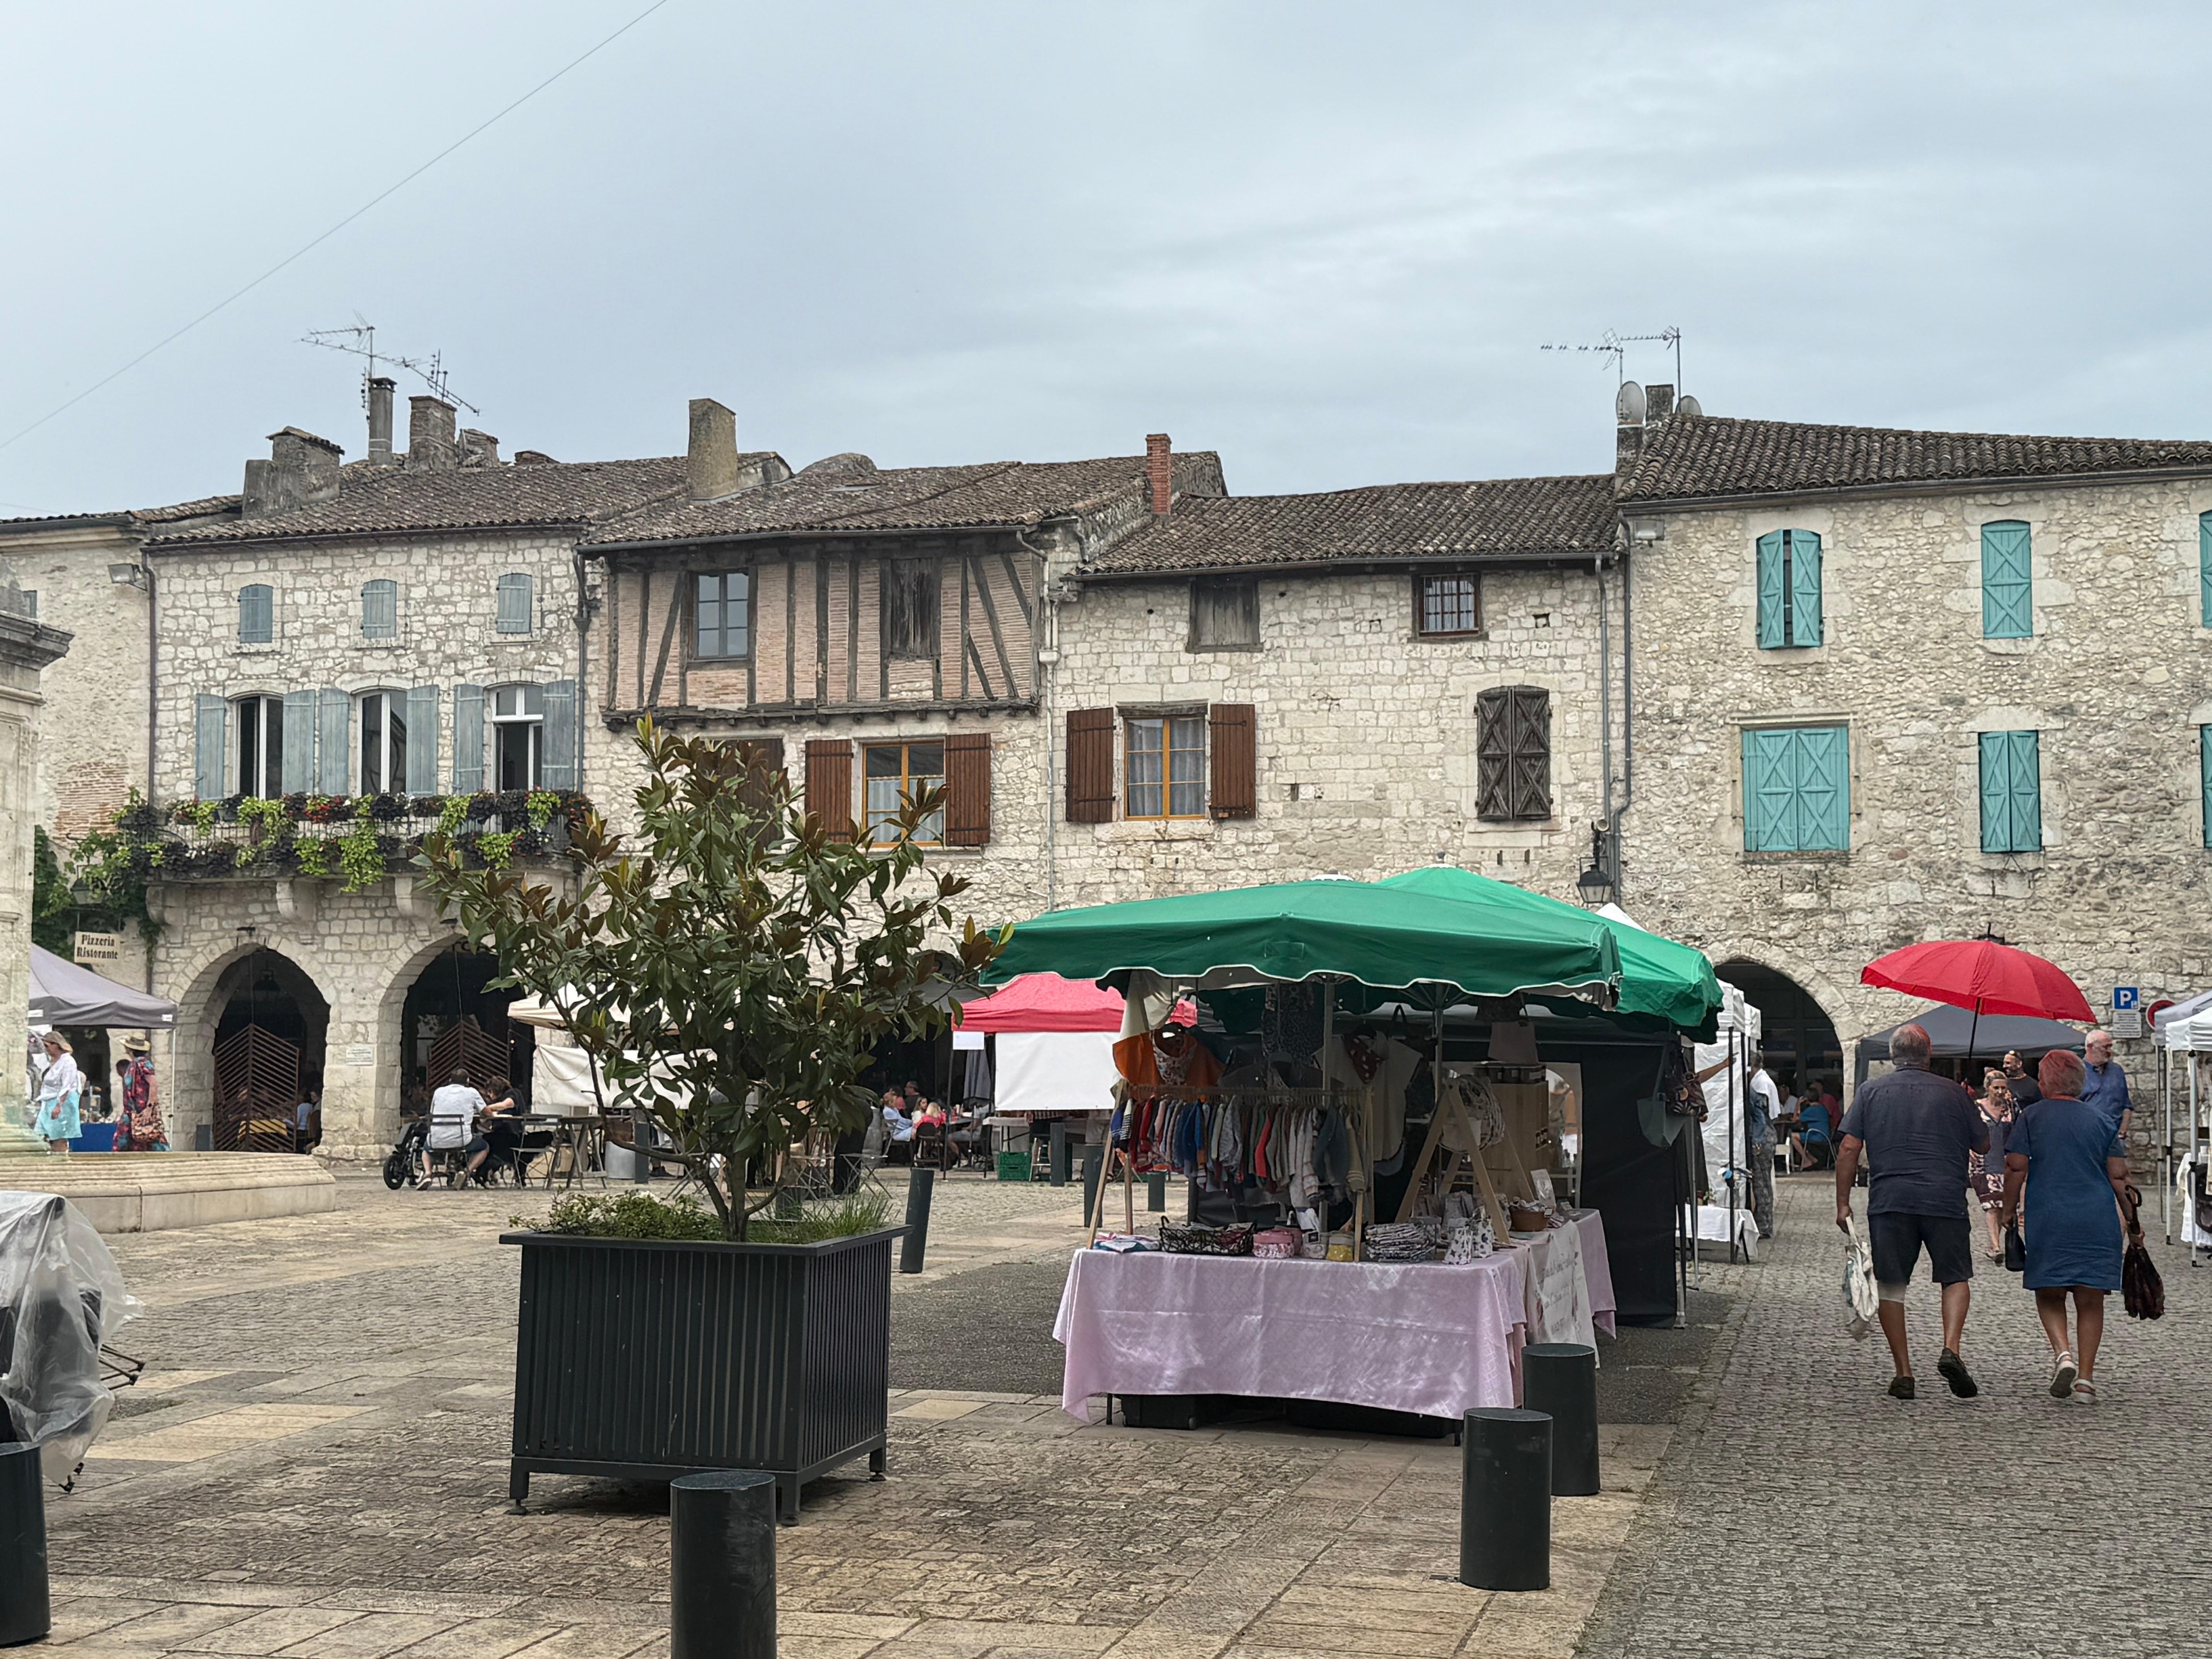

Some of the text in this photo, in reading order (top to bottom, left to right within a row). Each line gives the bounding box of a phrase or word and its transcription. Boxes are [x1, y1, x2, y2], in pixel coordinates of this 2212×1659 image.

[82, 934, 115, 946] Pizzeria
[77, 947, 118, 959] Ristorante
[2120, 991, 2132, 1006] P
